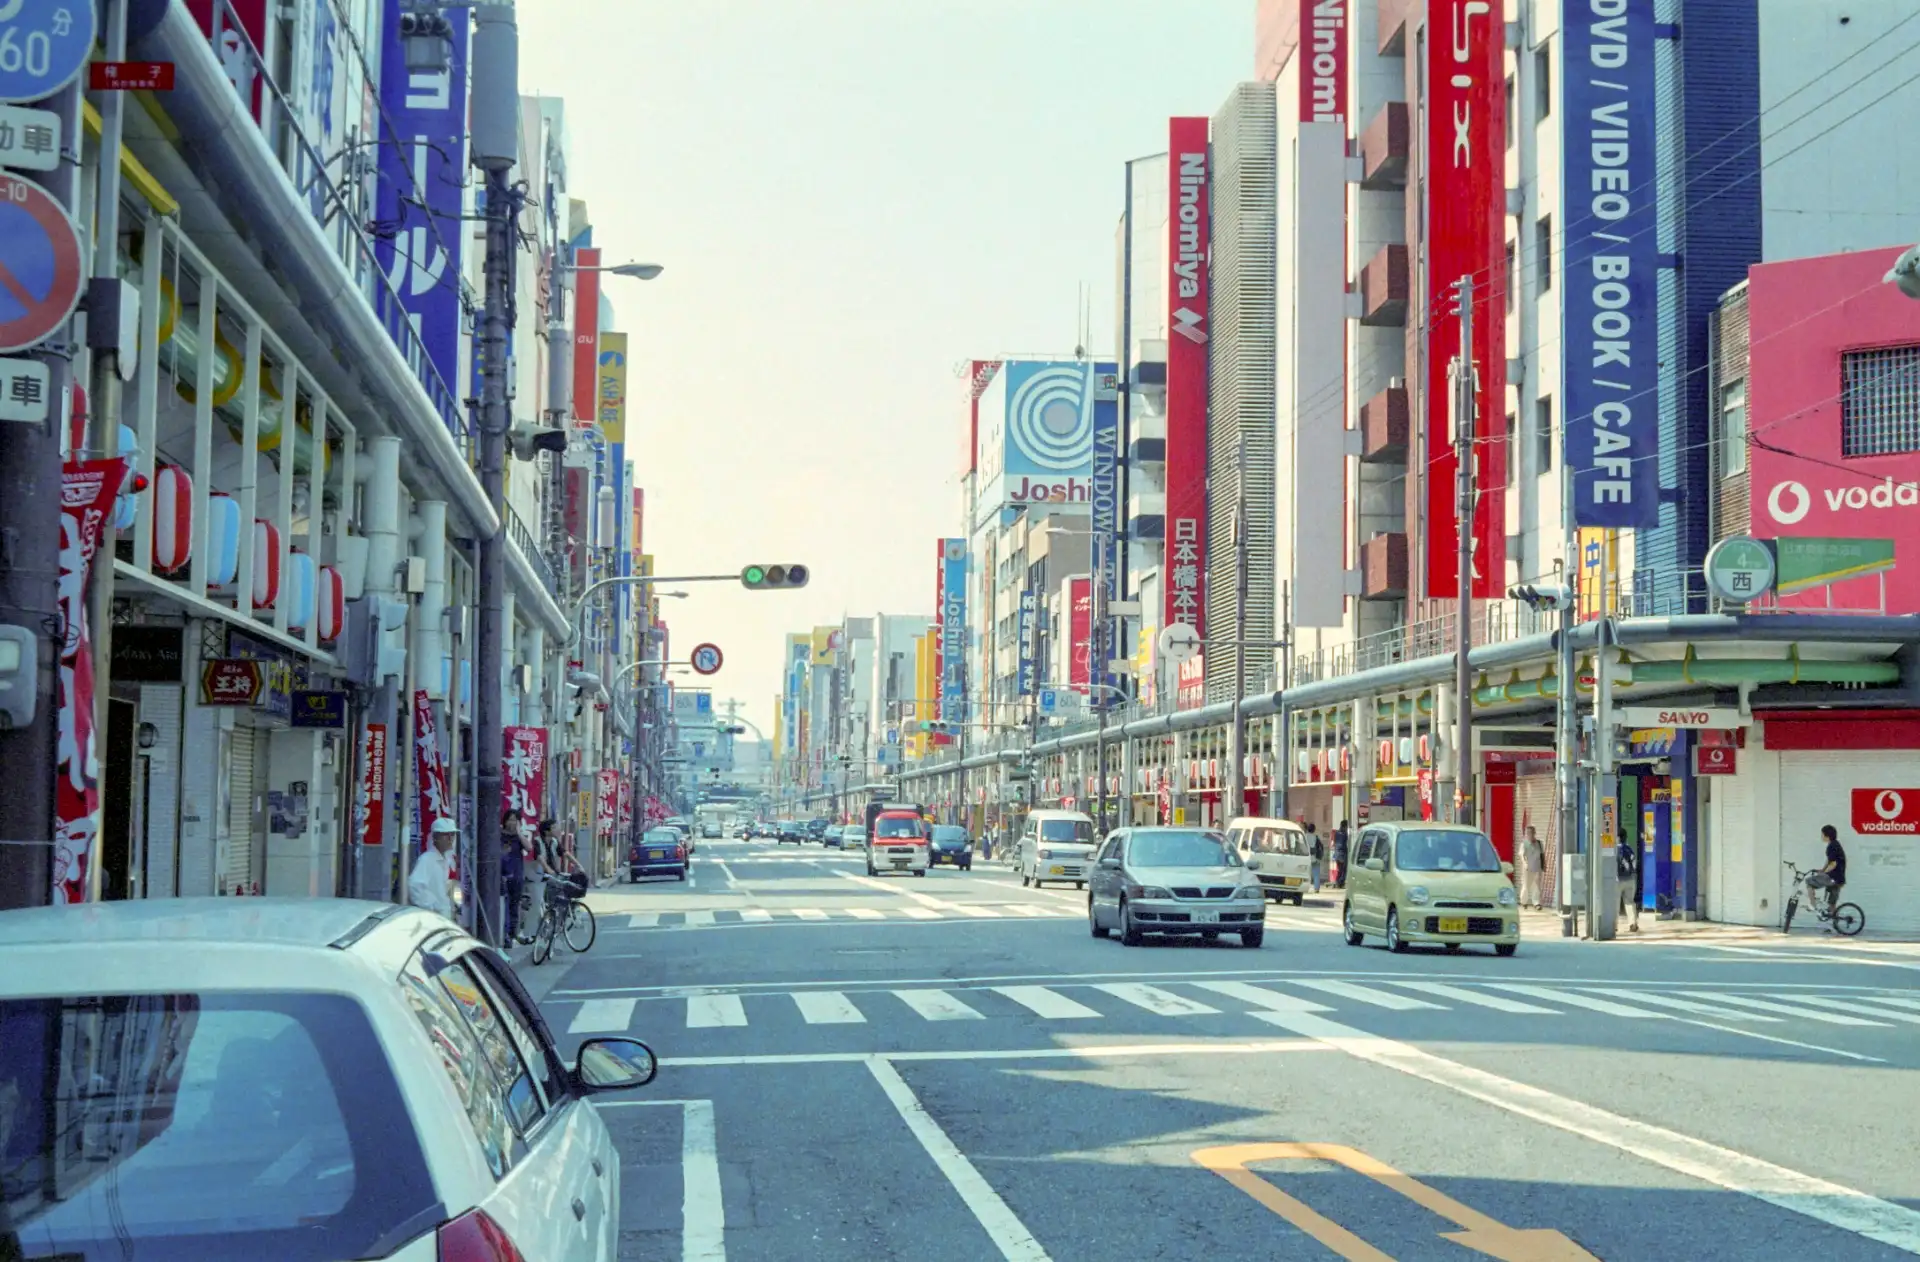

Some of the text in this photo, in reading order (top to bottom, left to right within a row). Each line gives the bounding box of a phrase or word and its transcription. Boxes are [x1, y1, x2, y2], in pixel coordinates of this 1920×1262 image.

[1591, 101, 1630, 221] VIDEO
[1173, 153, 1205, 298] Ninomiya
[1592, 256, 1631, 368] BOOK
[577, 334, 594, 345] au
[1593, 401, 1632, 504] CAFE
[1732, 571, 1752, 591] 西
[215, 675, 251, 695] 王将
[1658, 711, 1709, 724] SANYO
[1862, 820, 1915, 832] vodafone
